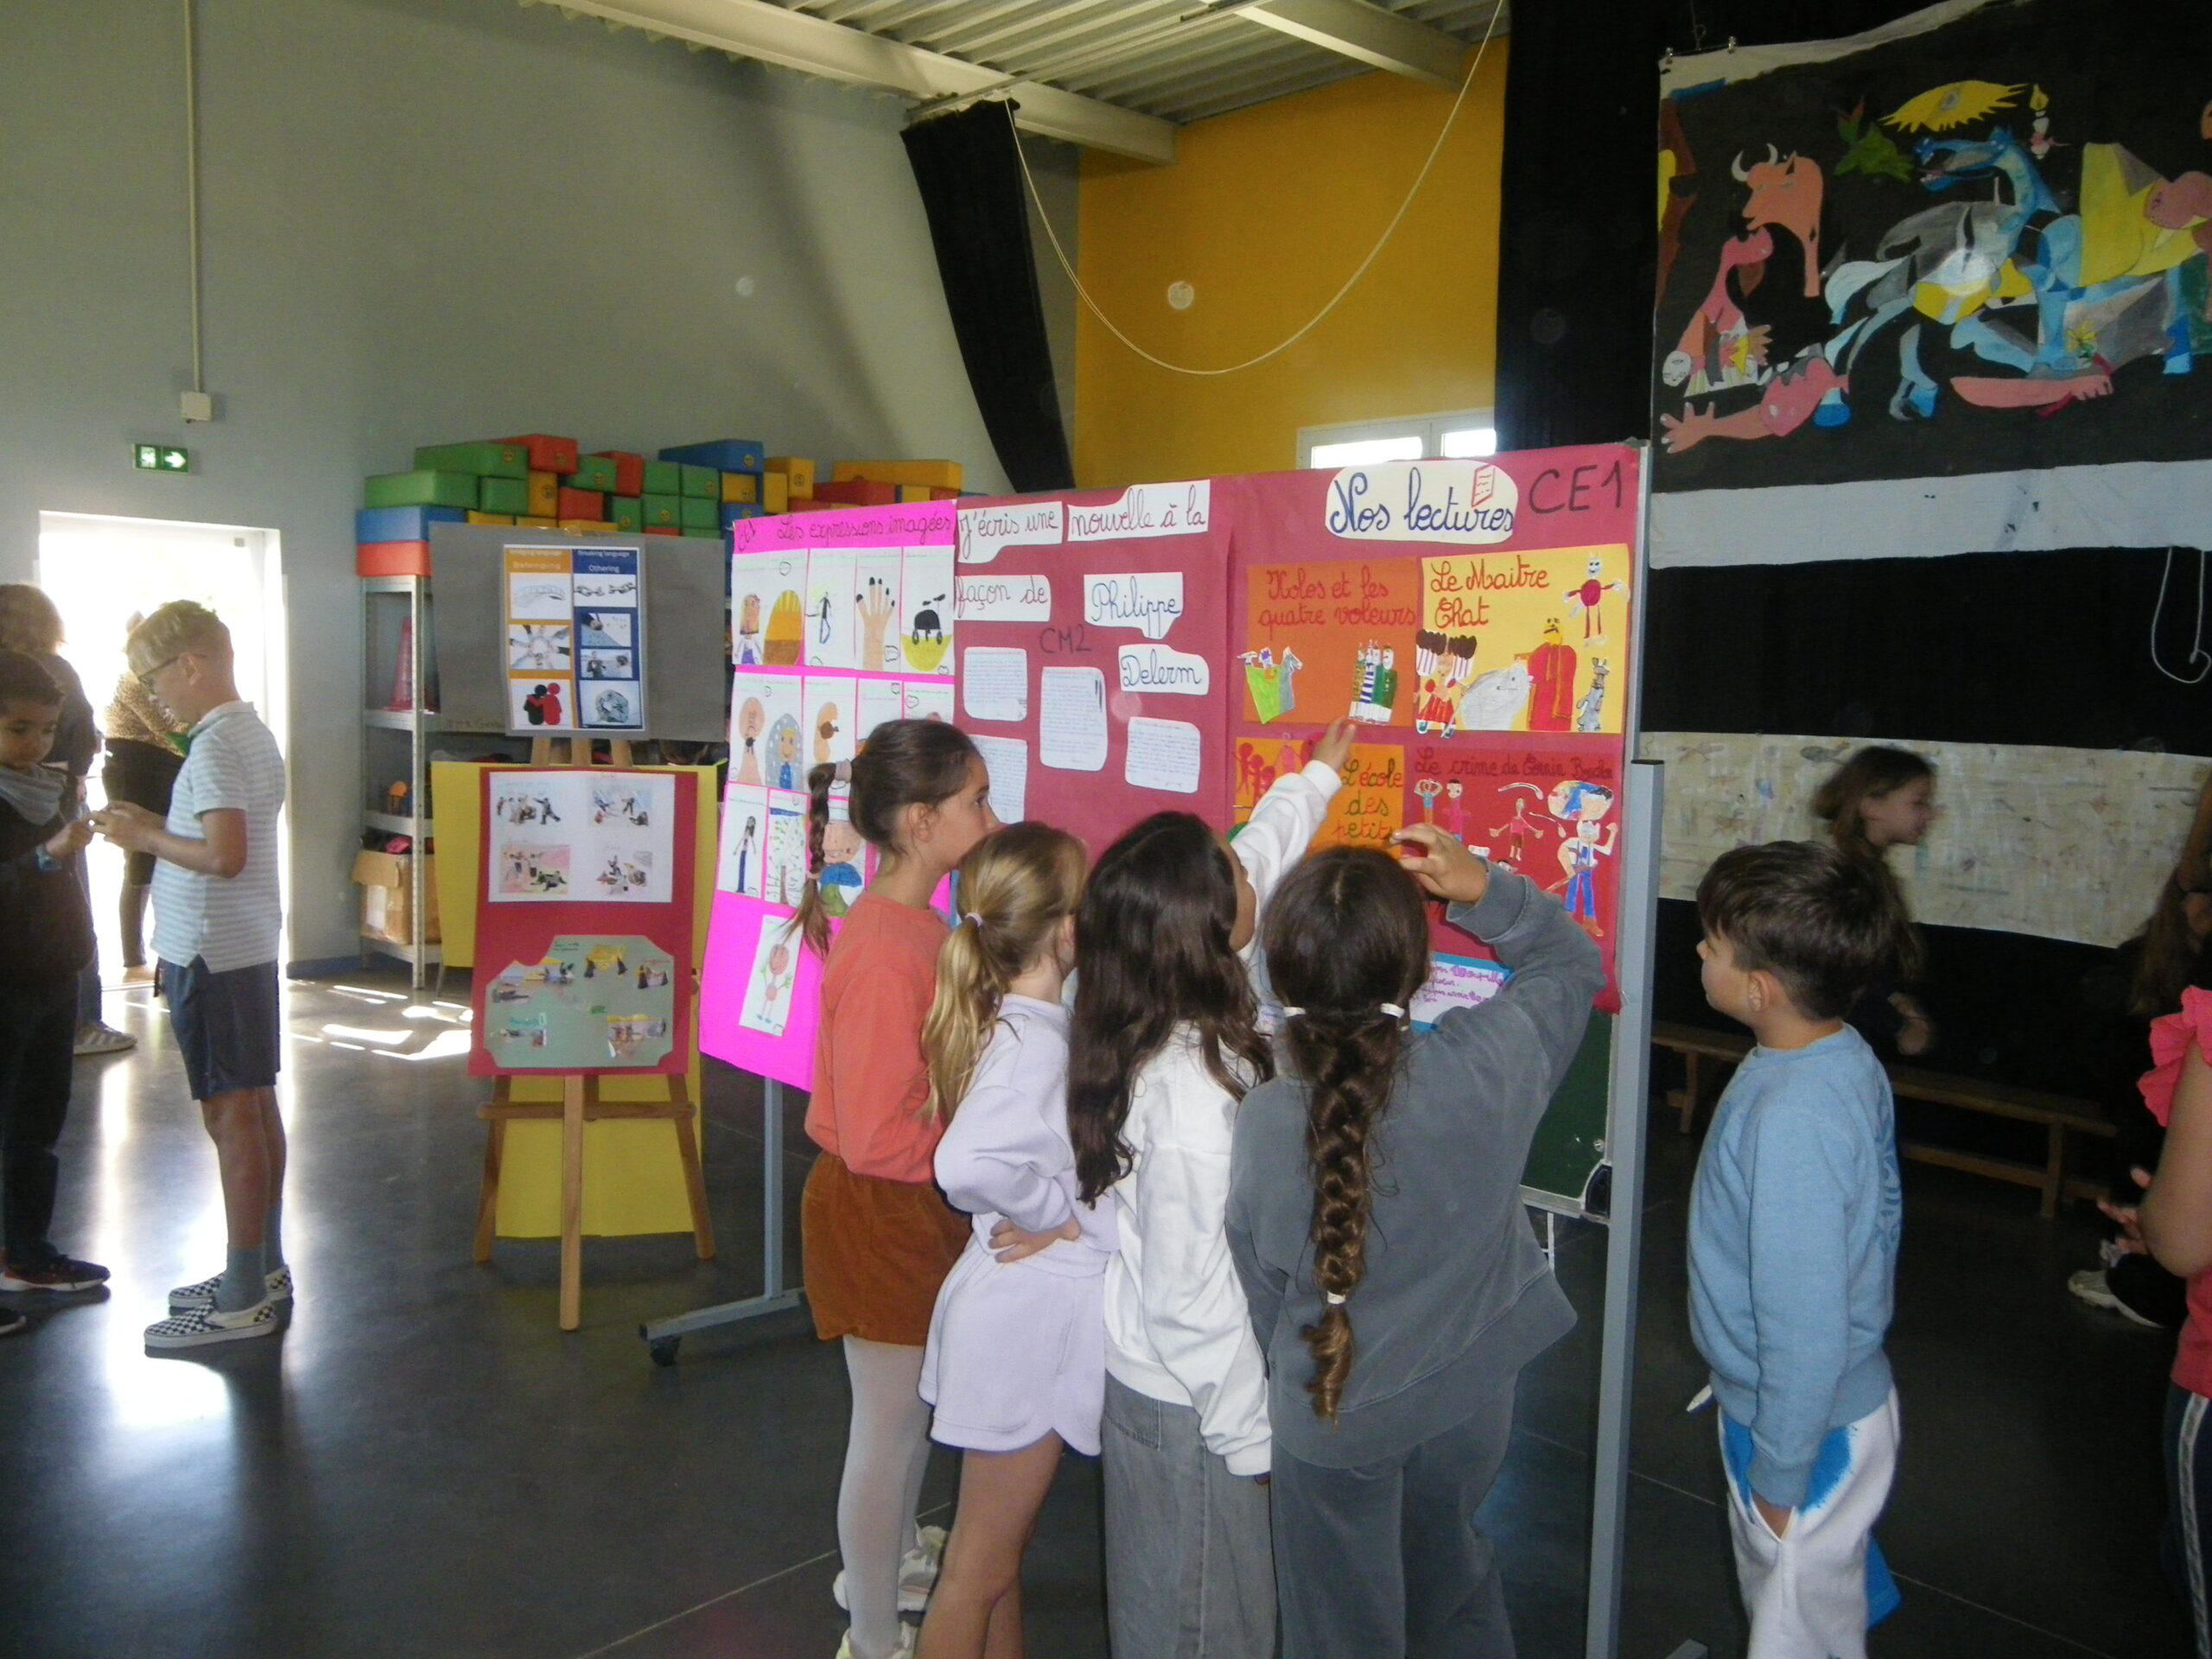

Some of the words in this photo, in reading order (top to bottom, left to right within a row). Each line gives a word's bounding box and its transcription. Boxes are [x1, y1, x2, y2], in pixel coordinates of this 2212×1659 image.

[1330, 472, 1390, 535] Nos
[1403, 467, 1514, 534] lectures
[1528, 461, 1623, 514] CE1
[778, 514, 804, 540] Les
[810, 520, 883, 546] expressions
[888, 510, 951, 544] imagées
[959, 513, 1020, 559] J'écris
[1027, 508, 1058, 531] une
[1071, 486, 1154, 537] nouvelle
[1160, 503, 1178, 528] à
[1186, 484, 1206, 526] la
[1332, 570, 1351, 599] et
[1361, 565, 1389, 598] les
[1431, 561, 1463, 593] Le
[955, 577, 1011, 618] façon
[1020, 575, 1048, 604] de
[1091, 575, 1181, 638] Philippe
[1434, 595, 1491, 629] Chat
[1258, 602, 1325, 640] quatre
[1334, 596, 1416, 626] voleurs
[1039, 625, 1092, 655] CM2
[1122, 648, 1202, 689] Delerm
[1340, 758, 1403, 788] L'école
[1414, 747, 1441, 776] Le
[1449, 755, 1497, 776] crime
[1501, 753, 1520, 776] de
[1344, 790, 1389, 817] des
[1332, 817, 1393, 843] petits
